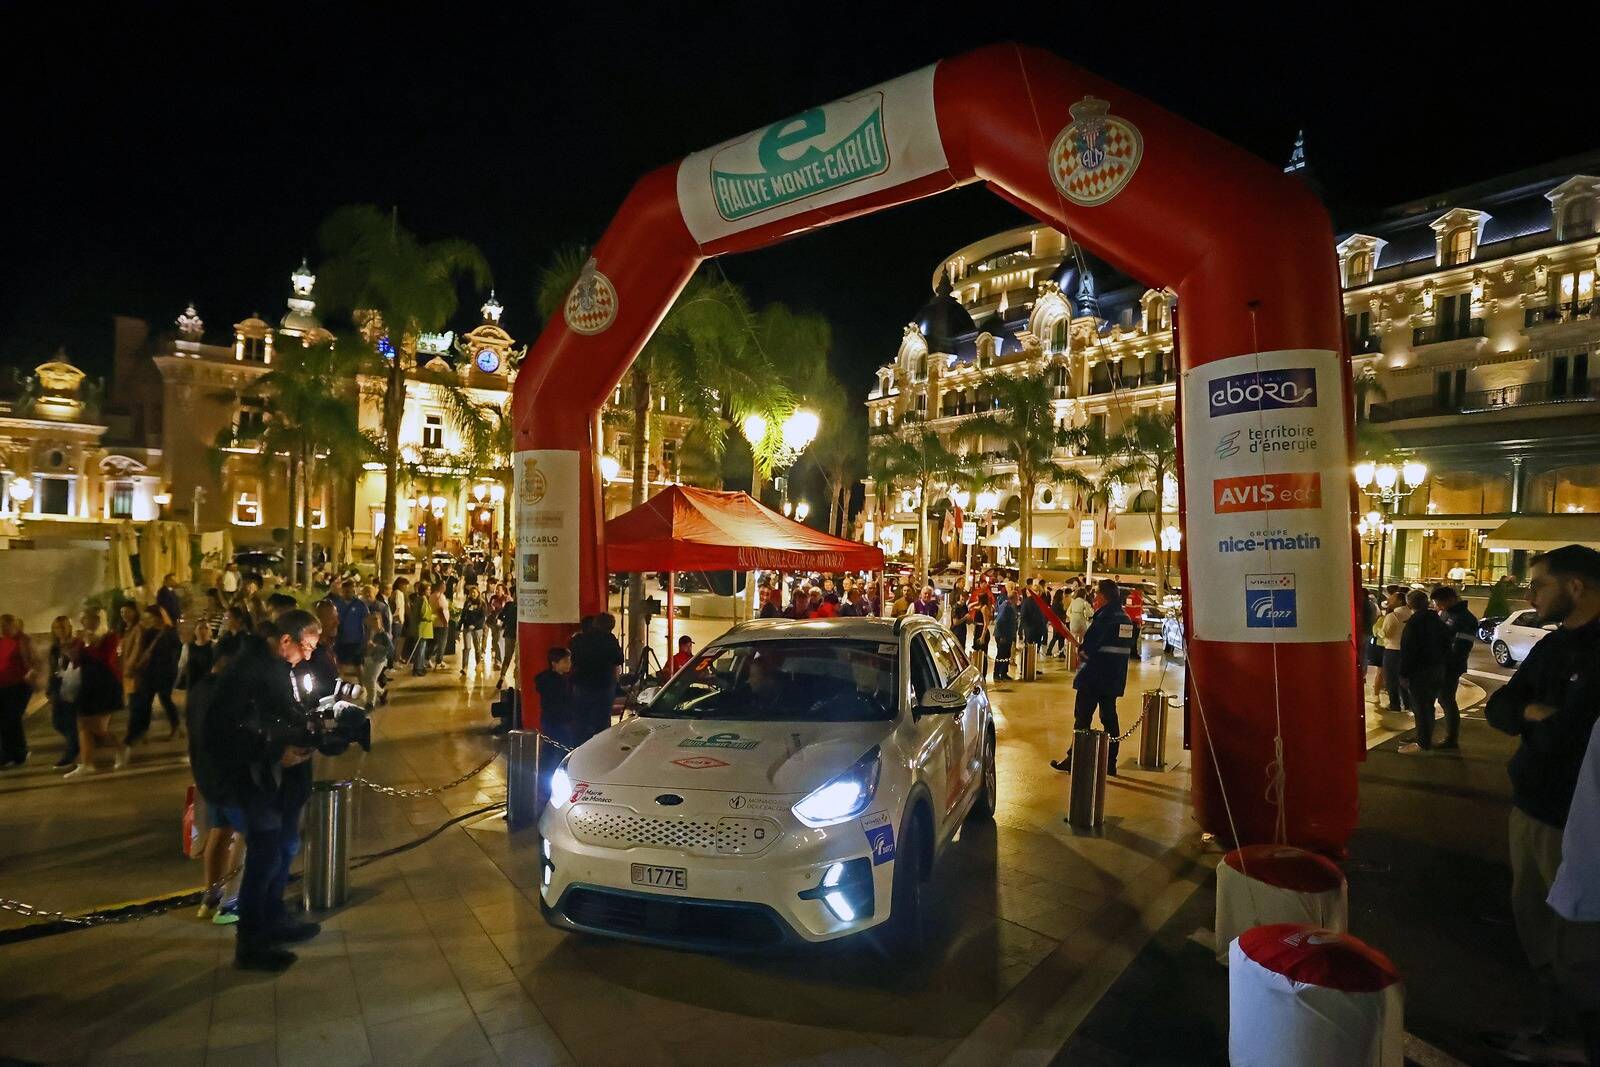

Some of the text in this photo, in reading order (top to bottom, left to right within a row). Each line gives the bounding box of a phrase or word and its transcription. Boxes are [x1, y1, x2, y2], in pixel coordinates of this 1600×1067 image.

[717, 123, 882, 214] RALLYE MONTE-CARLO
[1248, 425, 1315, 440] territoire
[1249, 438, 1318, 453] d'énergie
[1219, 483, 1275, 506] AVIS
[1249, 529, 1288, 537] GROUPE
[1218, 532, 1321, 553] nice-matin
[1265, 610, 1292, 618] 107.7
[589, 795, 613, 803] Monaco
[647, 867, 685, 887] 177E
